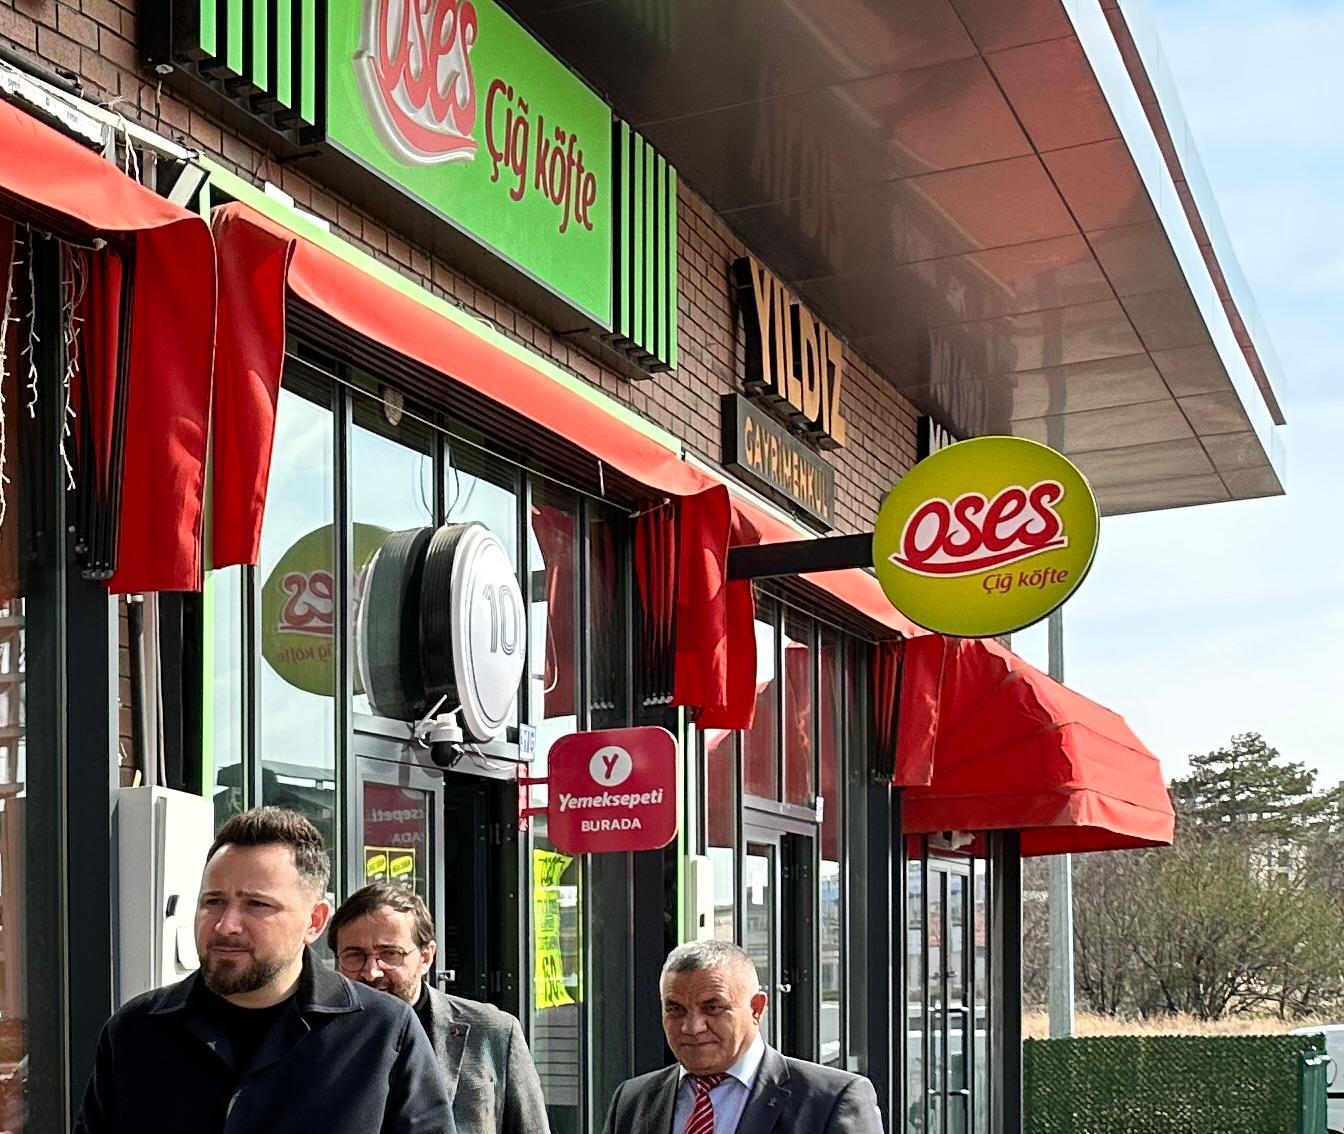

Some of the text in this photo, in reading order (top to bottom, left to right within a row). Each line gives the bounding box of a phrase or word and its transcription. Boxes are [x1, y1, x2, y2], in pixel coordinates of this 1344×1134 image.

[485, 78, 597, 234] Çiğ köfte
[749, 256, 848, 449] YILDIZ
[896, 482, 1065, 572] oses
[1018, 566, 1069, 590] köfte
[559, 788, 664, 812] Yemeksepeti
[581, 818, 642, 832] BURADA
